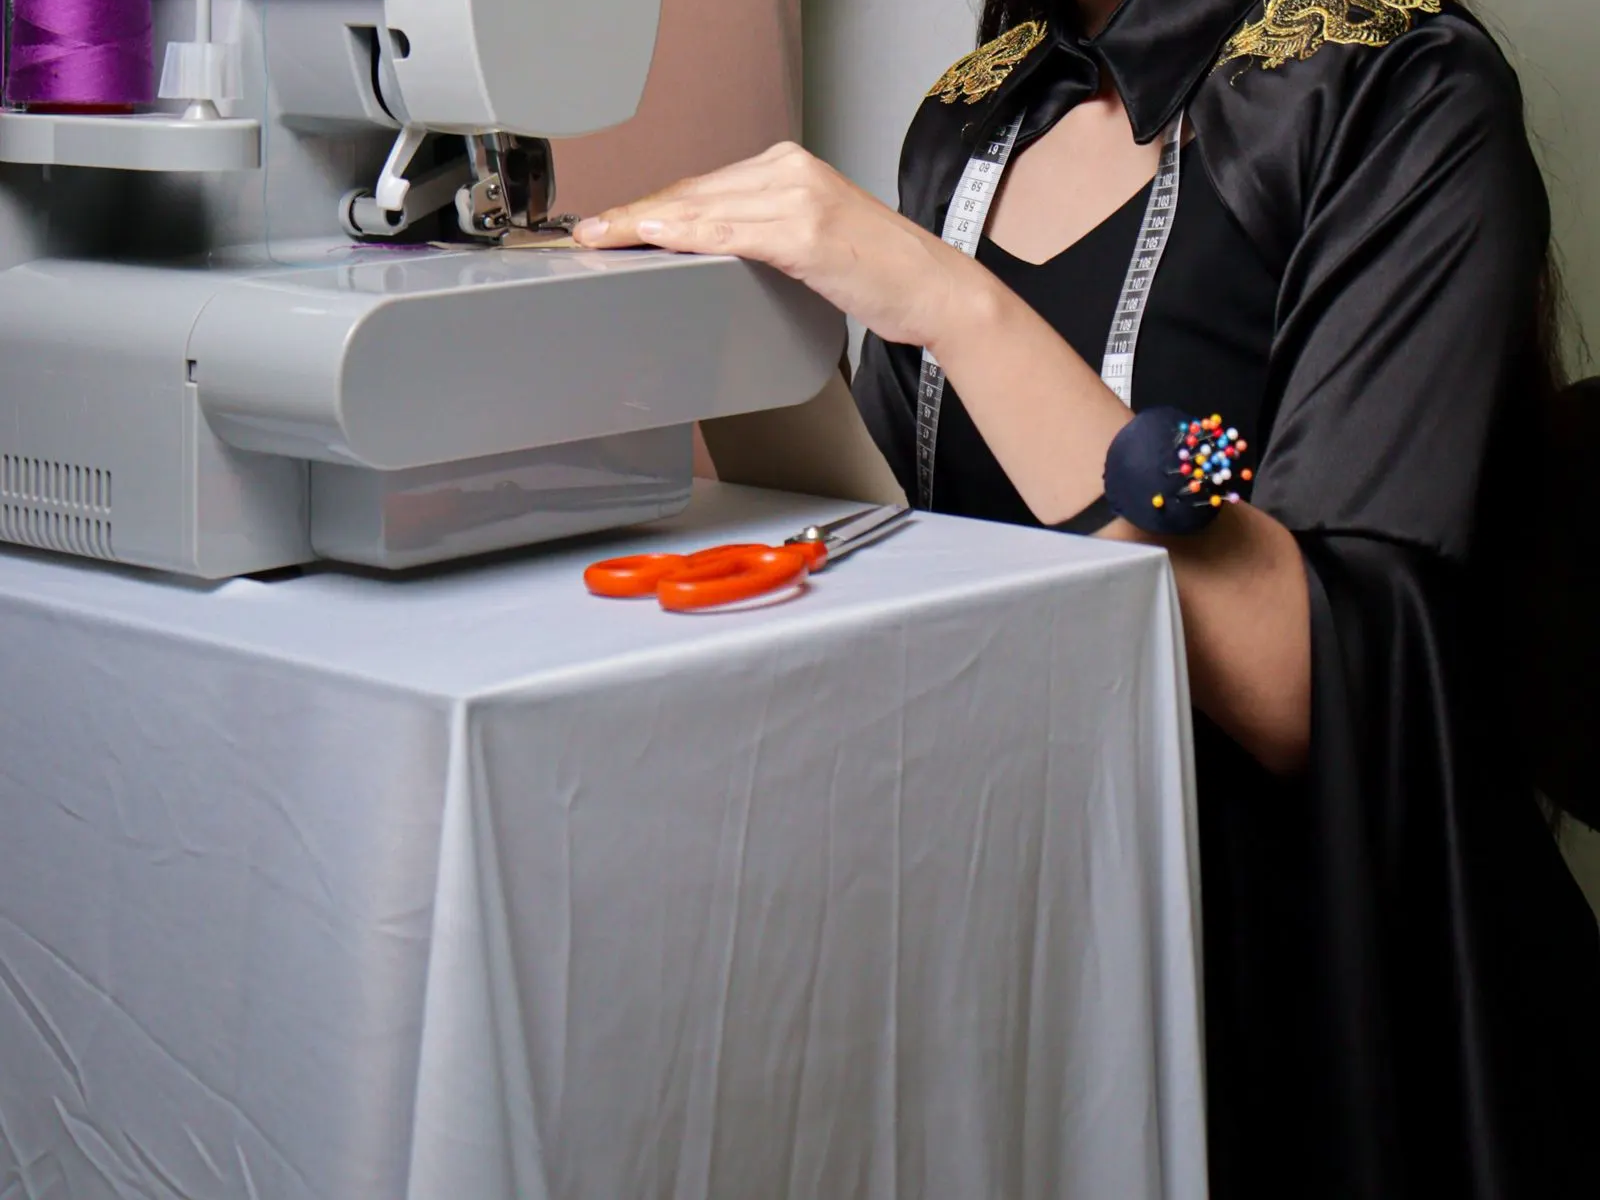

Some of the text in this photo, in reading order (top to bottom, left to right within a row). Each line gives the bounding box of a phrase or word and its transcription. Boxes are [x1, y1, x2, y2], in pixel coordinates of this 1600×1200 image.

[988, 144, 999, 155] 61
[979, 162, 990, 173] 60
[1162, 173, 1173, 186] 102
[971, 182, 983, 192] 59
[964, 200, 975, 212] 58
[1158, 195, 1170, 207] 103
[957, 221, 968, 232] 57
[1152, 216, 1164, 228] 104
[1146, 238, 1158, 249] 105
[1133, 278, 1145, 289] 107
[1114, 341, 1127, 353] 110
